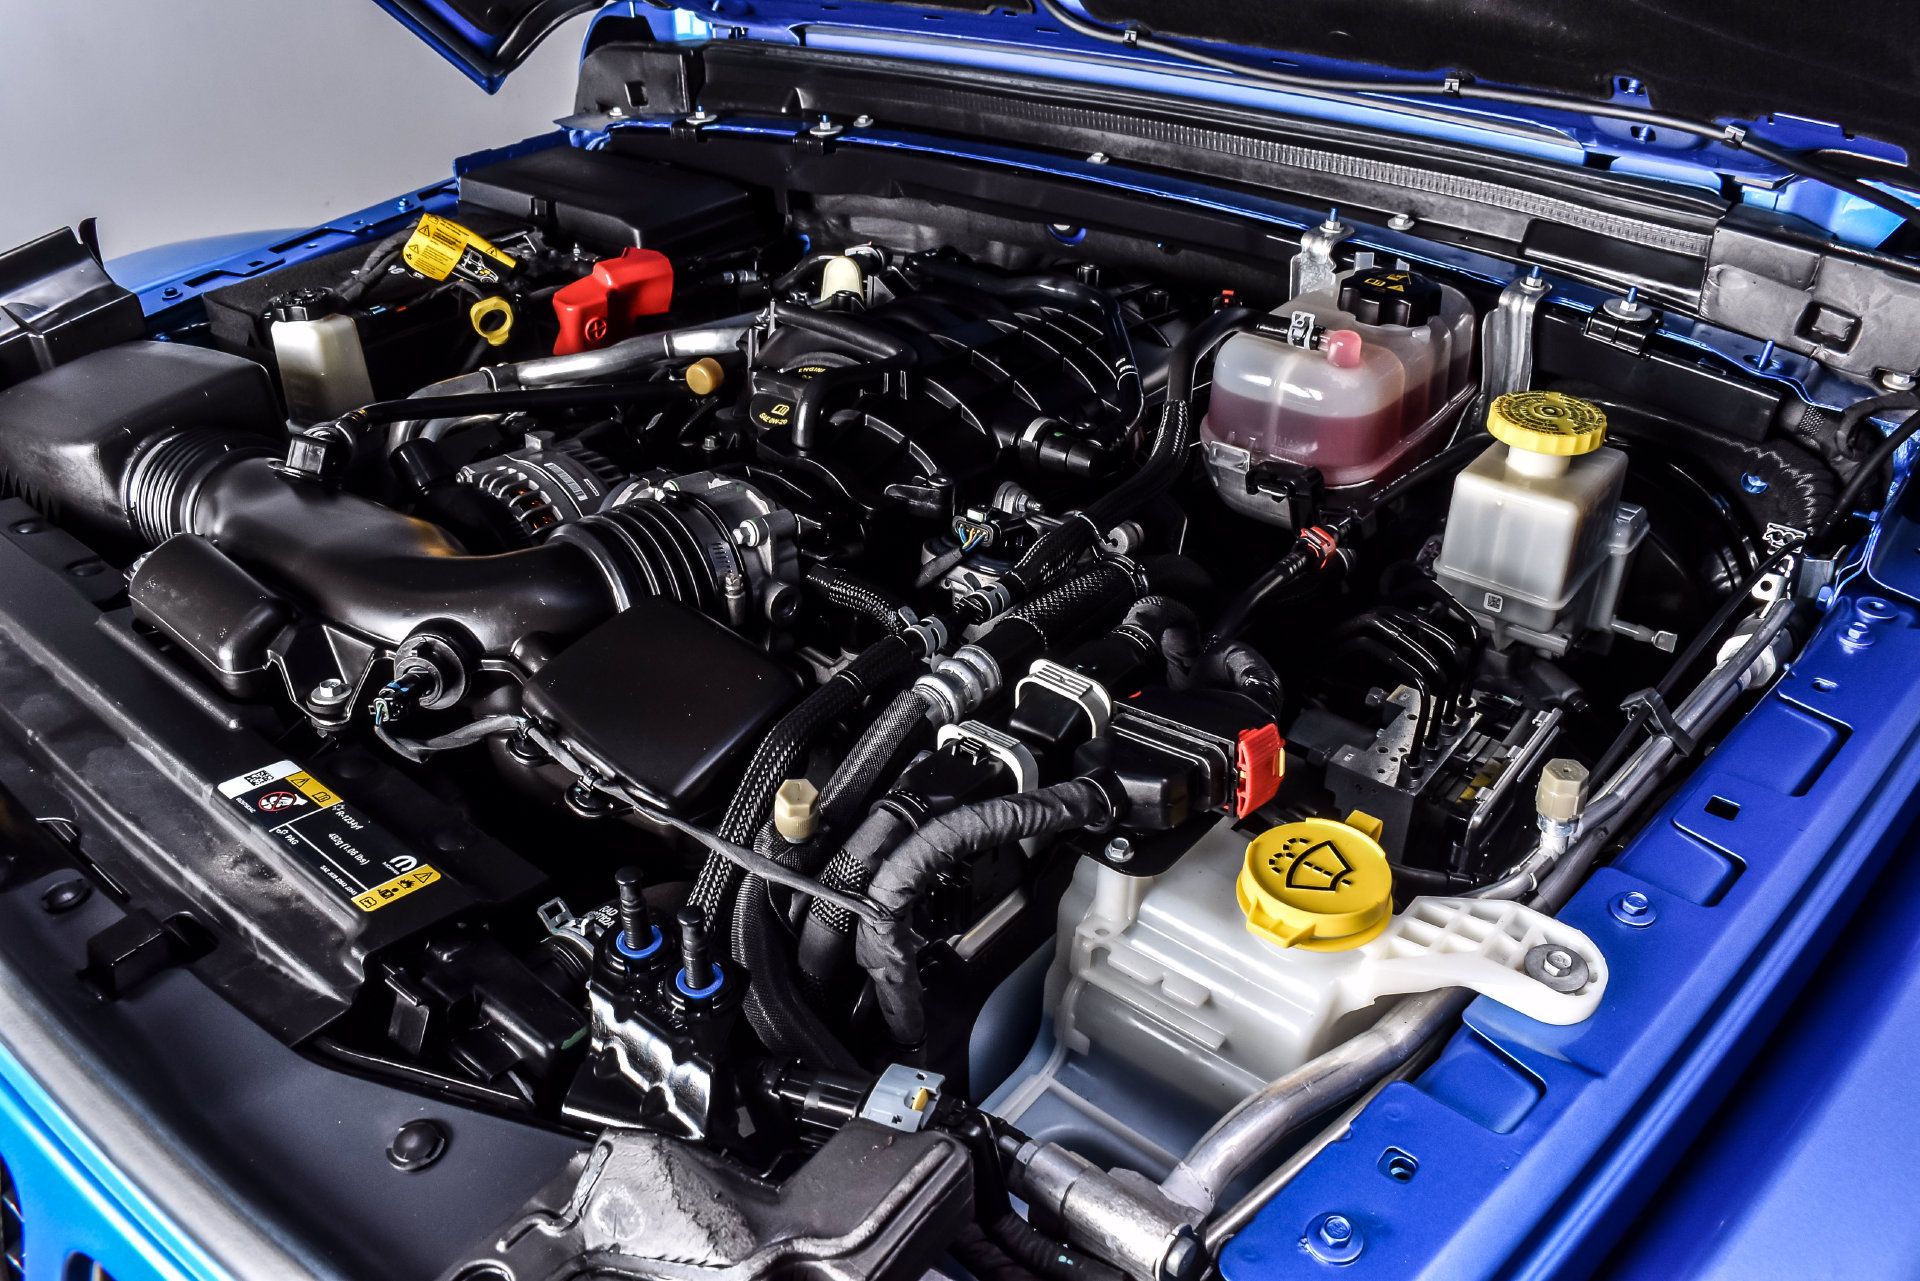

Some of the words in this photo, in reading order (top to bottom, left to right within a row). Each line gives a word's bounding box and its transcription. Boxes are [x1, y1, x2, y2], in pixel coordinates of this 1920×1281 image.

[759, 412, 770, 423] SAE
[335, 810, 364, 830] R-1234yf
[284, 834, 300, 845] PAG
[354, 853, 370, 866] lbs)
